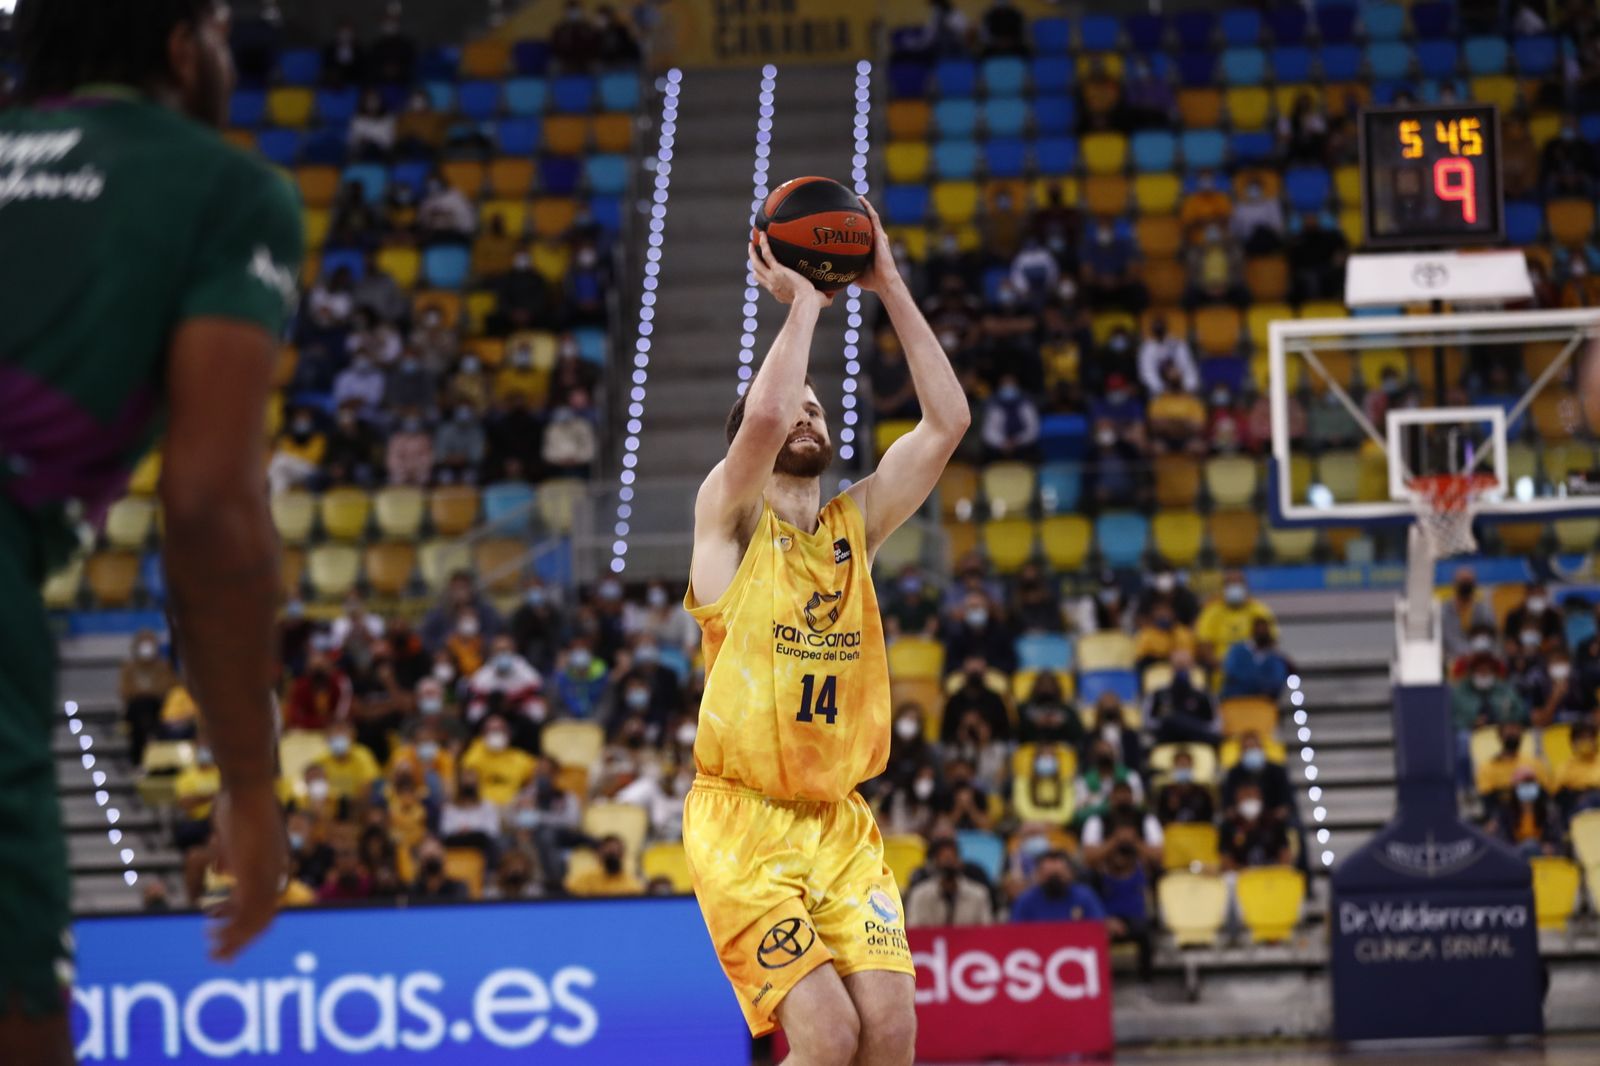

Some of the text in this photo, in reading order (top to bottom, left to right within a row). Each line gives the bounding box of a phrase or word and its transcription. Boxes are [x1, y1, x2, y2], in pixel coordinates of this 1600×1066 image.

[1400, 117, 1483, 159] 5 45
[1433, 157, 1477, 224] 9
[776, 643, 822, 660] Europea
[823, 651, 837, 661] del
[796, 673, 838, 725] 14
[867, 934, 888, 946] del
